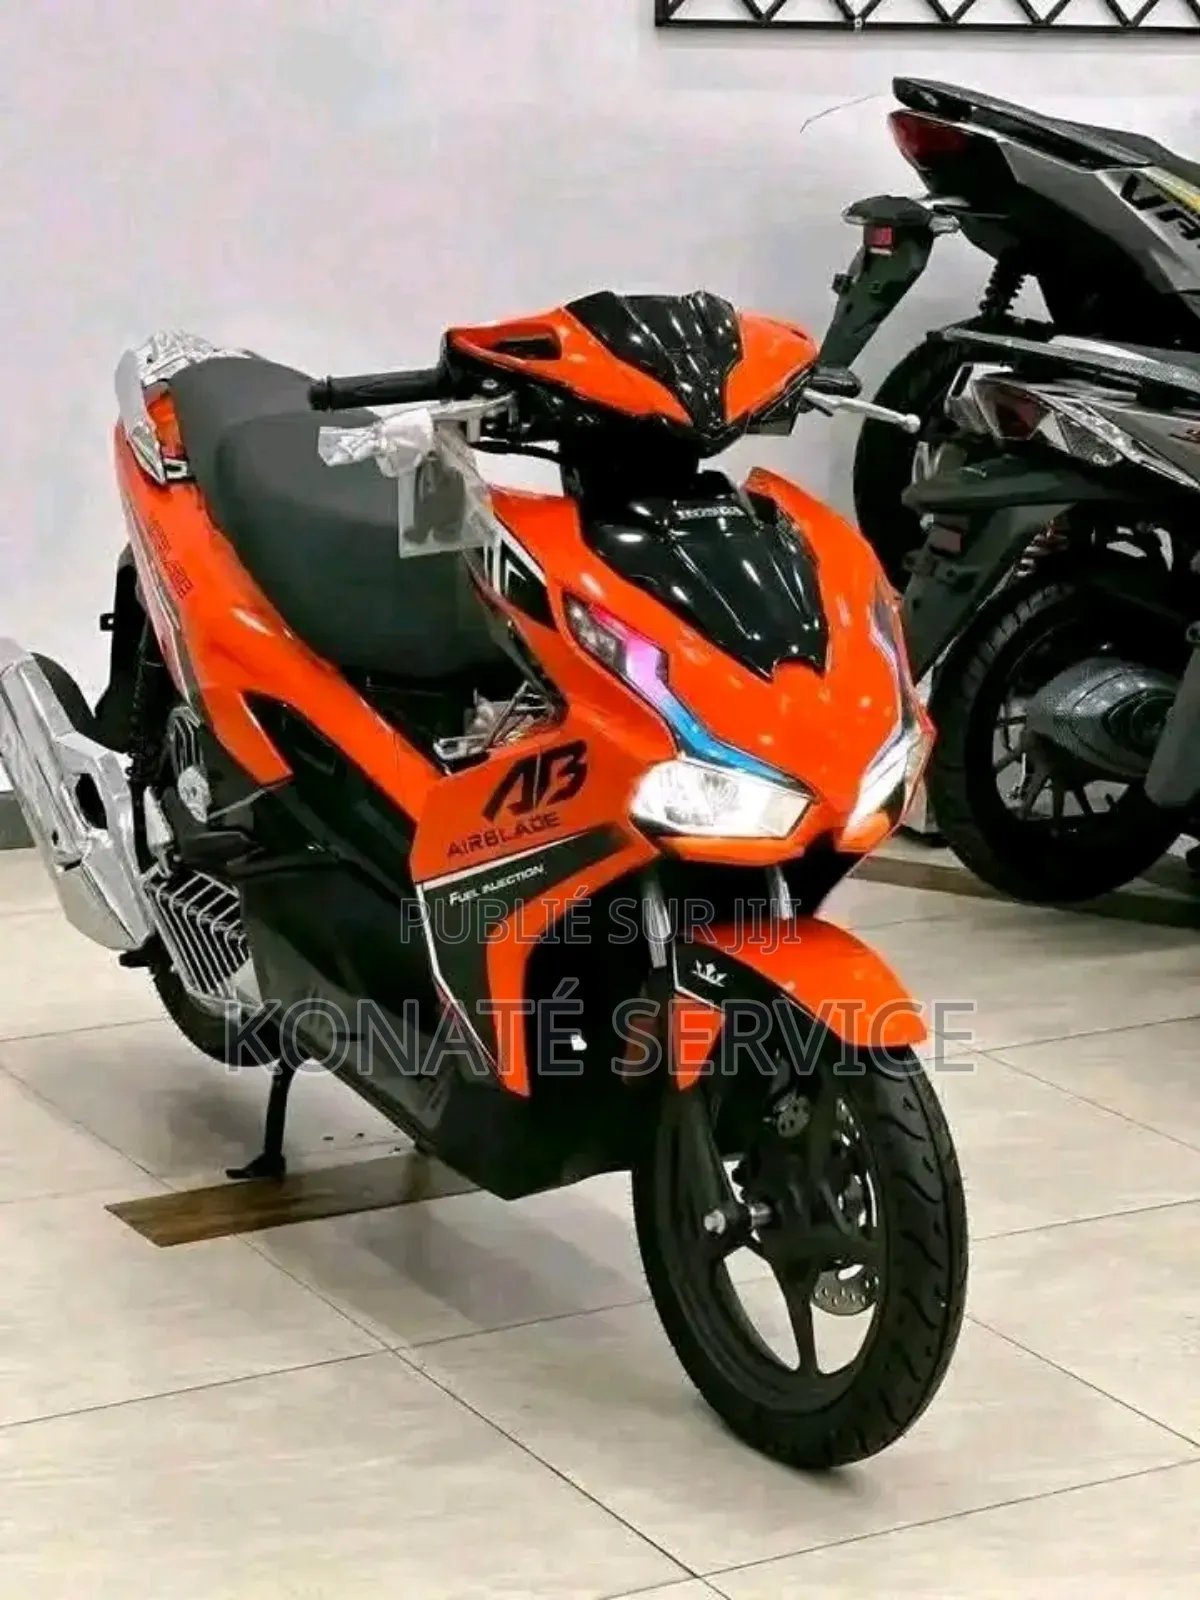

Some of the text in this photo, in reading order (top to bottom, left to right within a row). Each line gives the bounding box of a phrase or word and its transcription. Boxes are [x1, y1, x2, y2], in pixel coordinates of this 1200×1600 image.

[1119, 173, 1200, 250] VA
[481, 740, 588, 822] AB
[446, 811, 561, 859] AIRBLADE
